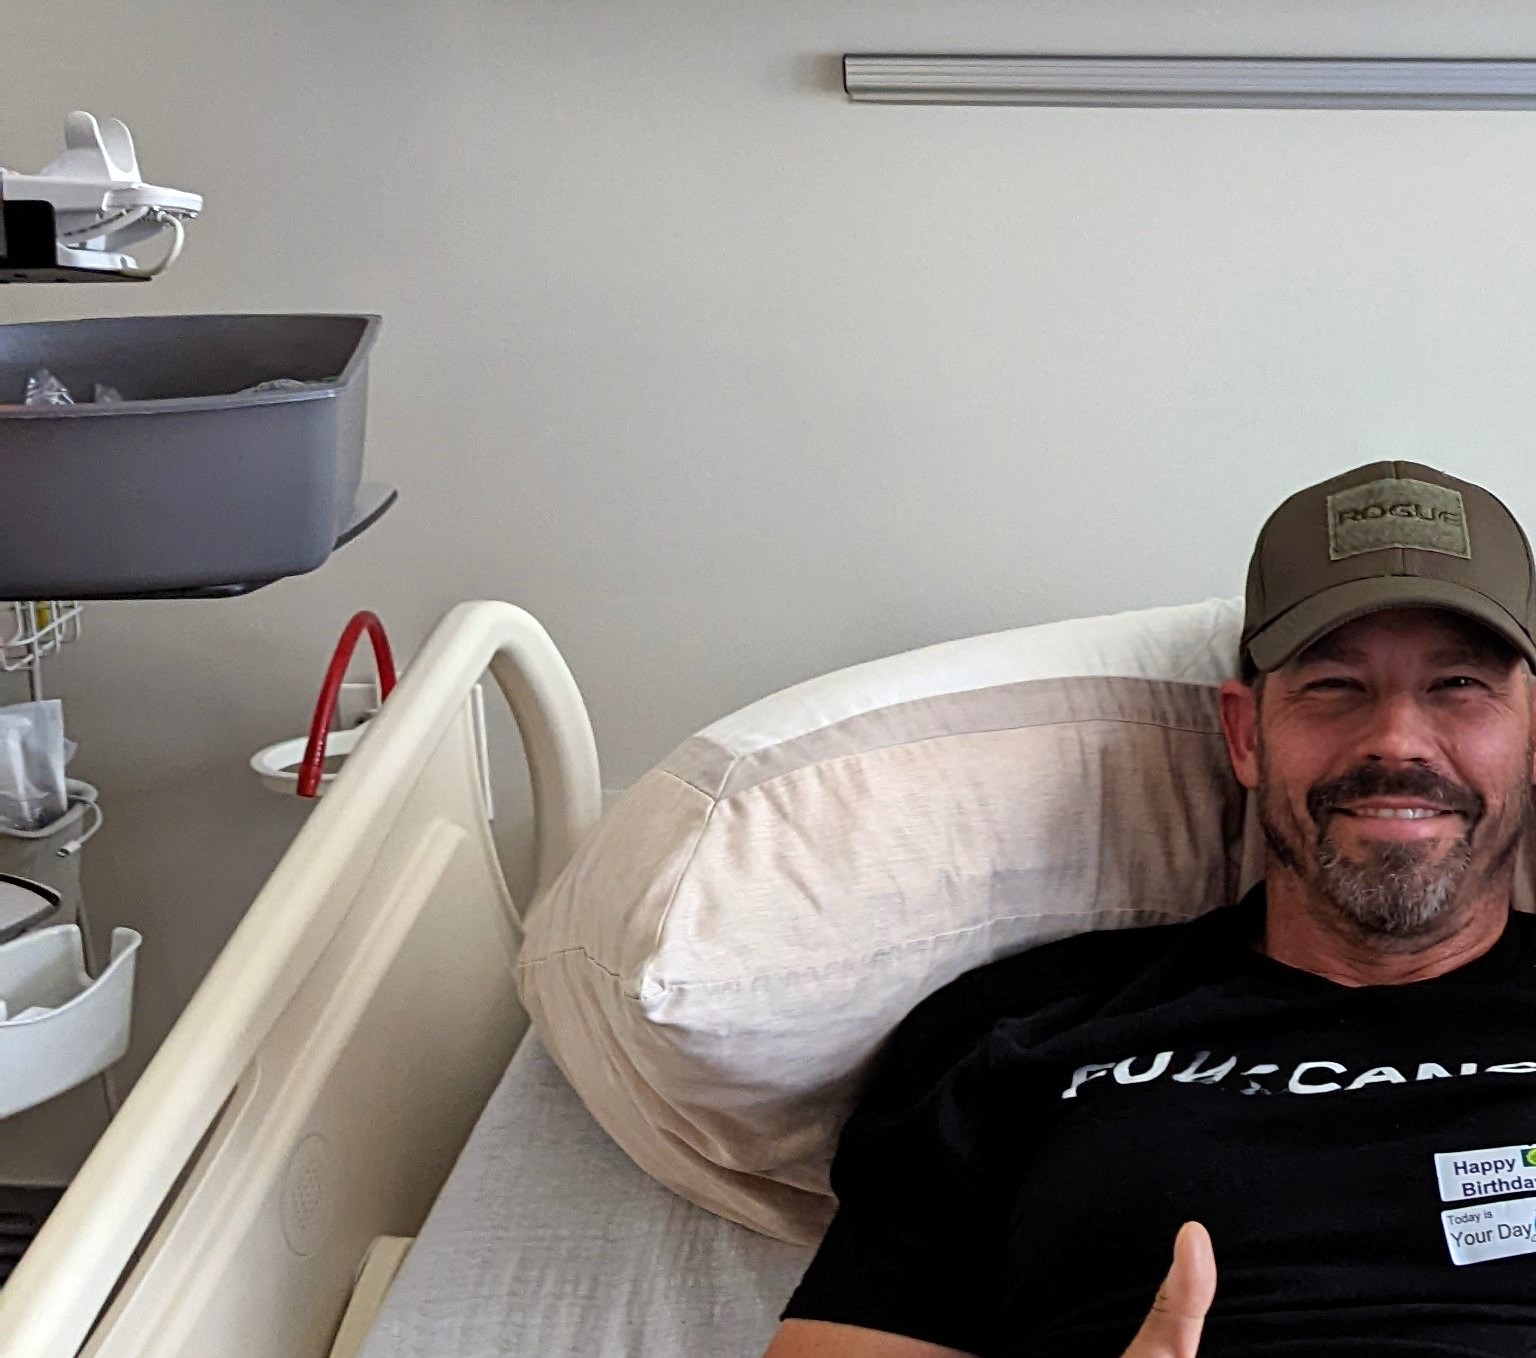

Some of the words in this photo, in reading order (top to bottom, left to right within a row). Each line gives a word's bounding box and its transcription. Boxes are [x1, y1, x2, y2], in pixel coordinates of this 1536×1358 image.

[1338, 502, 1462, 527] ROGUE
[1453, 1158, 1516, 1176] Happy
[1446, 1213, 1481, 1225] Today
[1484, 1210, 1493, 1219] is
[1451, 1229, 1493, 1248] Your
[1497, 1223, 1532, 1240] Day
